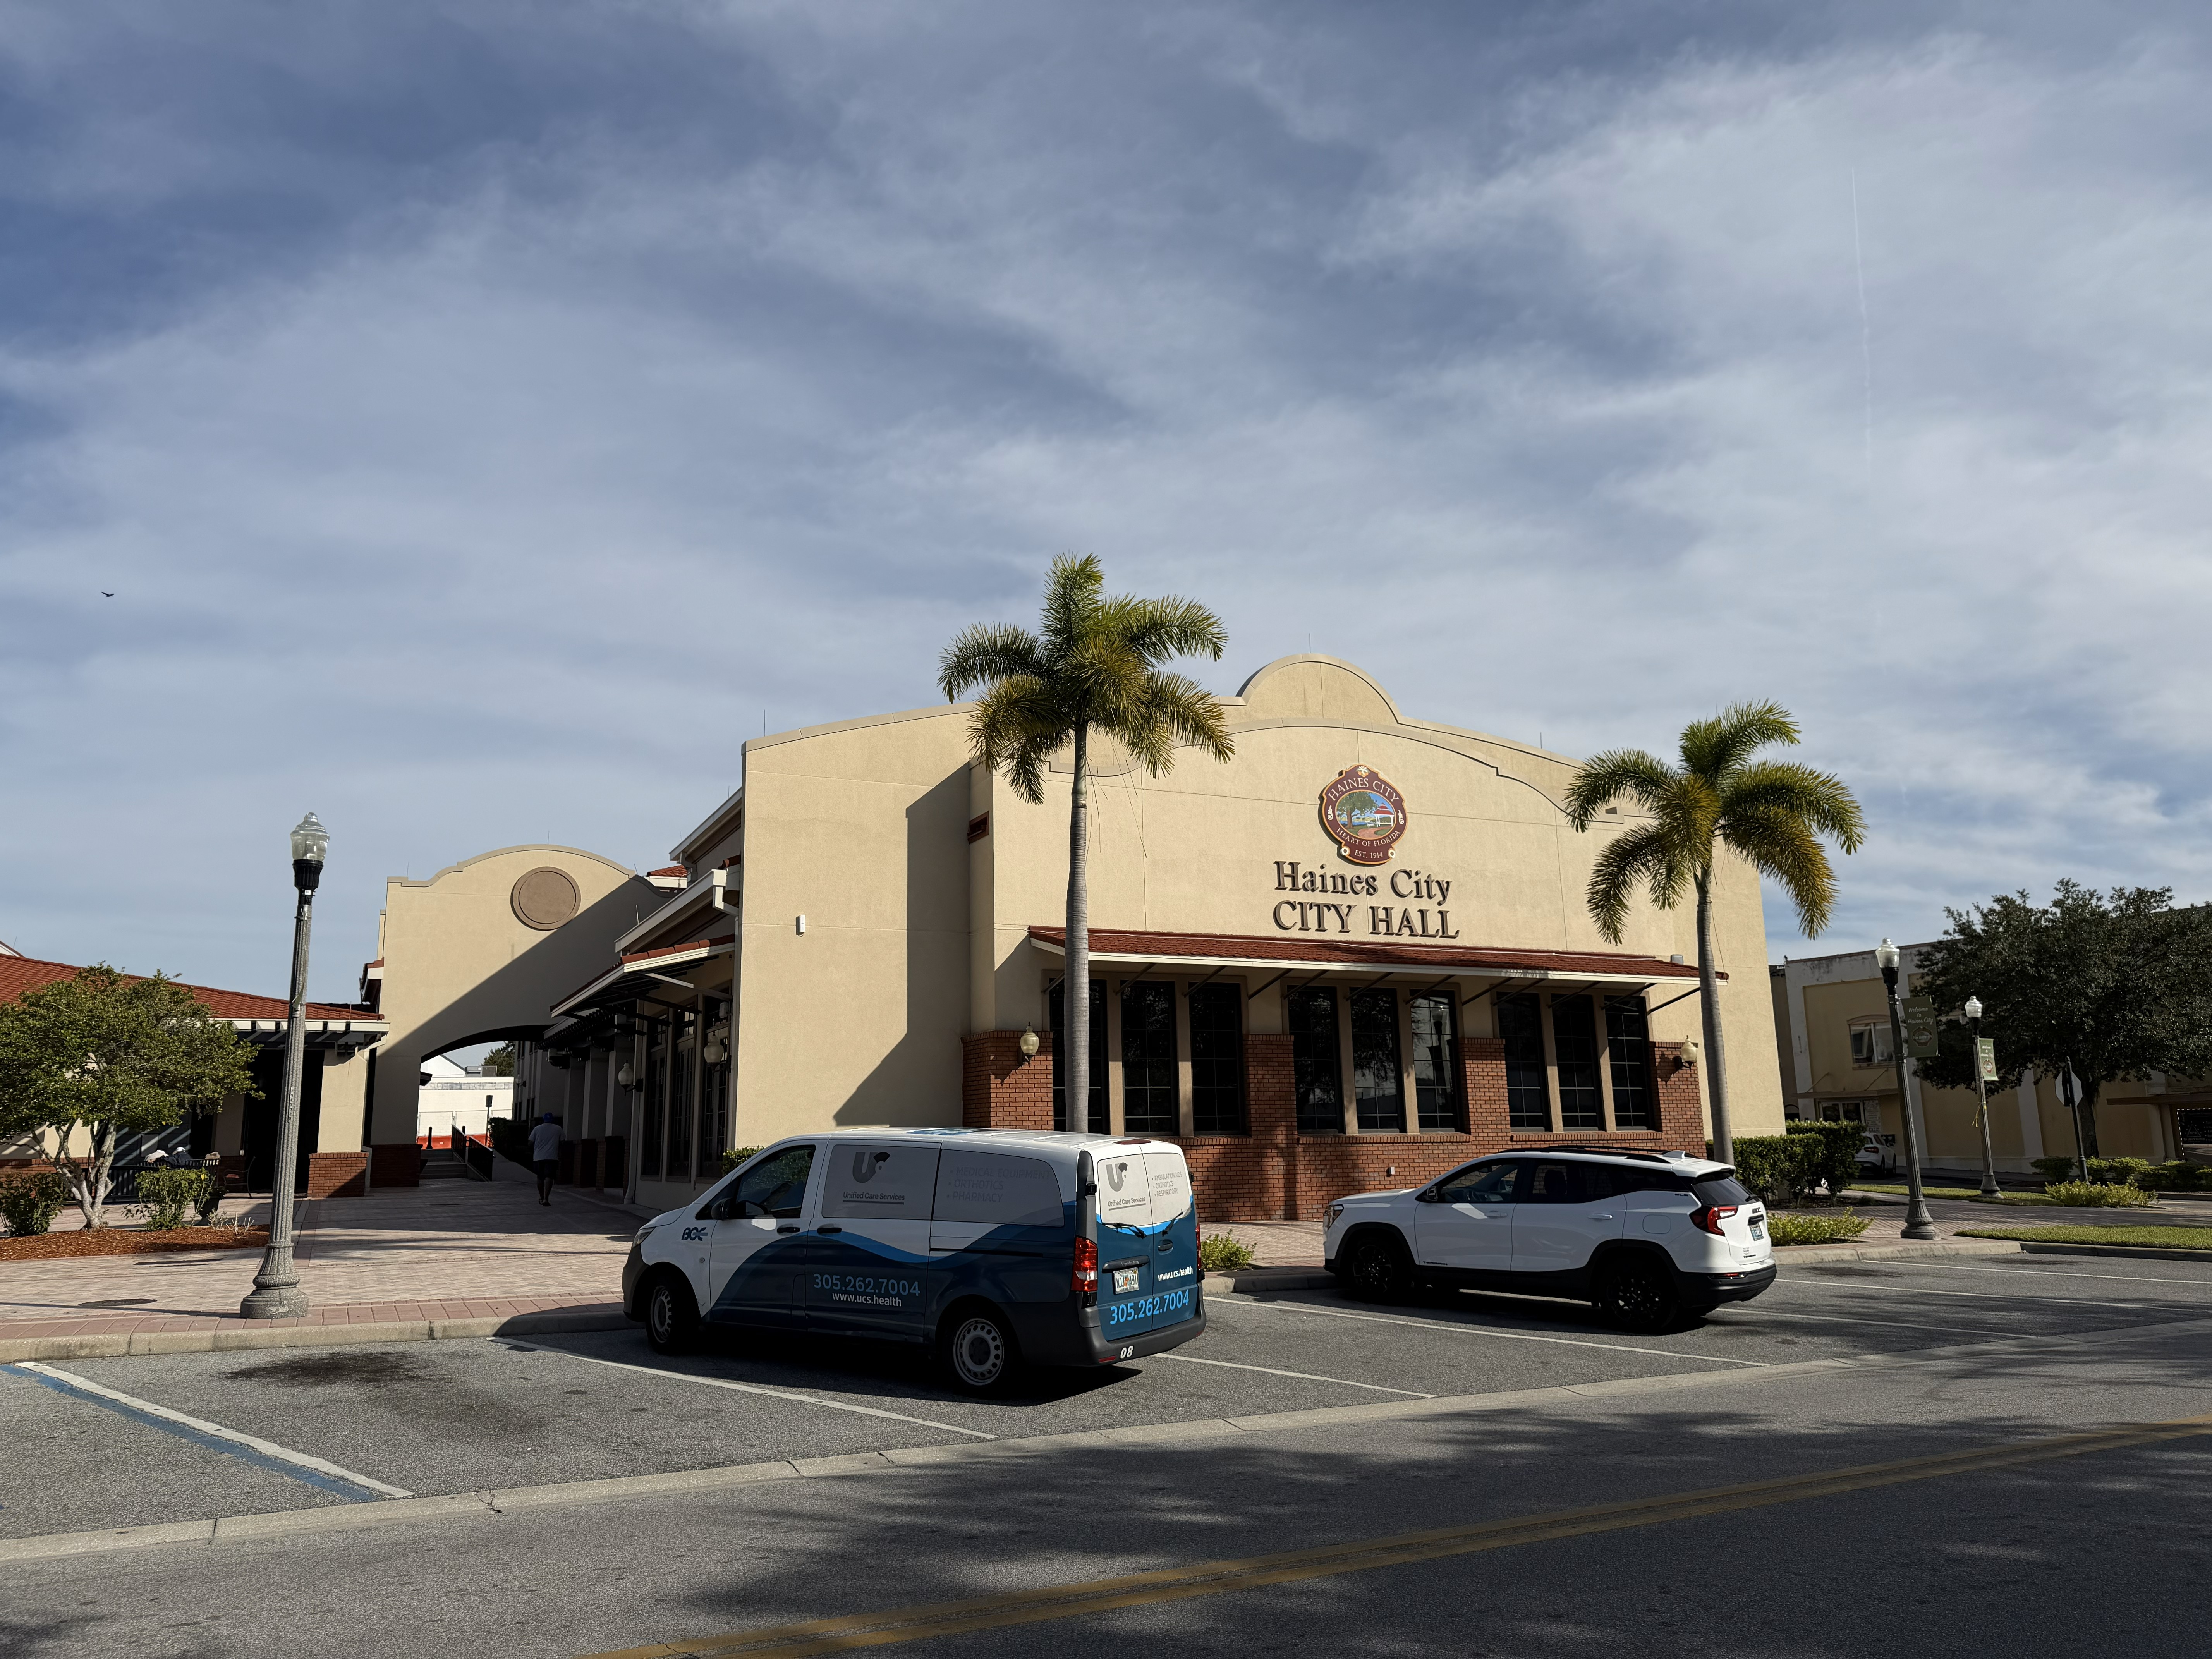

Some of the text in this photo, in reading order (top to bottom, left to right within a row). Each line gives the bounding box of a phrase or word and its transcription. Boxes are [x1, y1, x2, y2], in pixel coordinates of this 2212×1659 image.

[1328, 778, 1399, 802] HAINES CITY
[1336, 828, 1360, 845] HEART
[1374, 830, 1400, 846] FLORIDA
[1355, 850, 1367, 858] EST.
[1273, 861, 1453, 906] Haines City
[1273, 900, 1460, 939] CITY HALL
[956, 1166, 1052, 1180] MEDICAL EQUIPMENT
[1154, 1173, 1175, 1181] AMBULATION
[954, 1179, 1004, 1190] ORTHOTICS
[1156, 1181, 1174, 1189] ORTHOTICS
[952, 1191, 1004, 1203] PHARMACY
[1157, 1188, 1178, 1197] RESPIRATORY
[1108, 1199, 1121, 1207] Unified
[1158, 1266, 1193, 1281] www.ucs.health
[814, 1274, 920, 1296] 305.262.7004
[832, 1293, 902, 1307] www.ucs.health
[1110, 1289, 1189, 1324] 305.262.7004
[1120, 1346, 1133, 1358] 08
